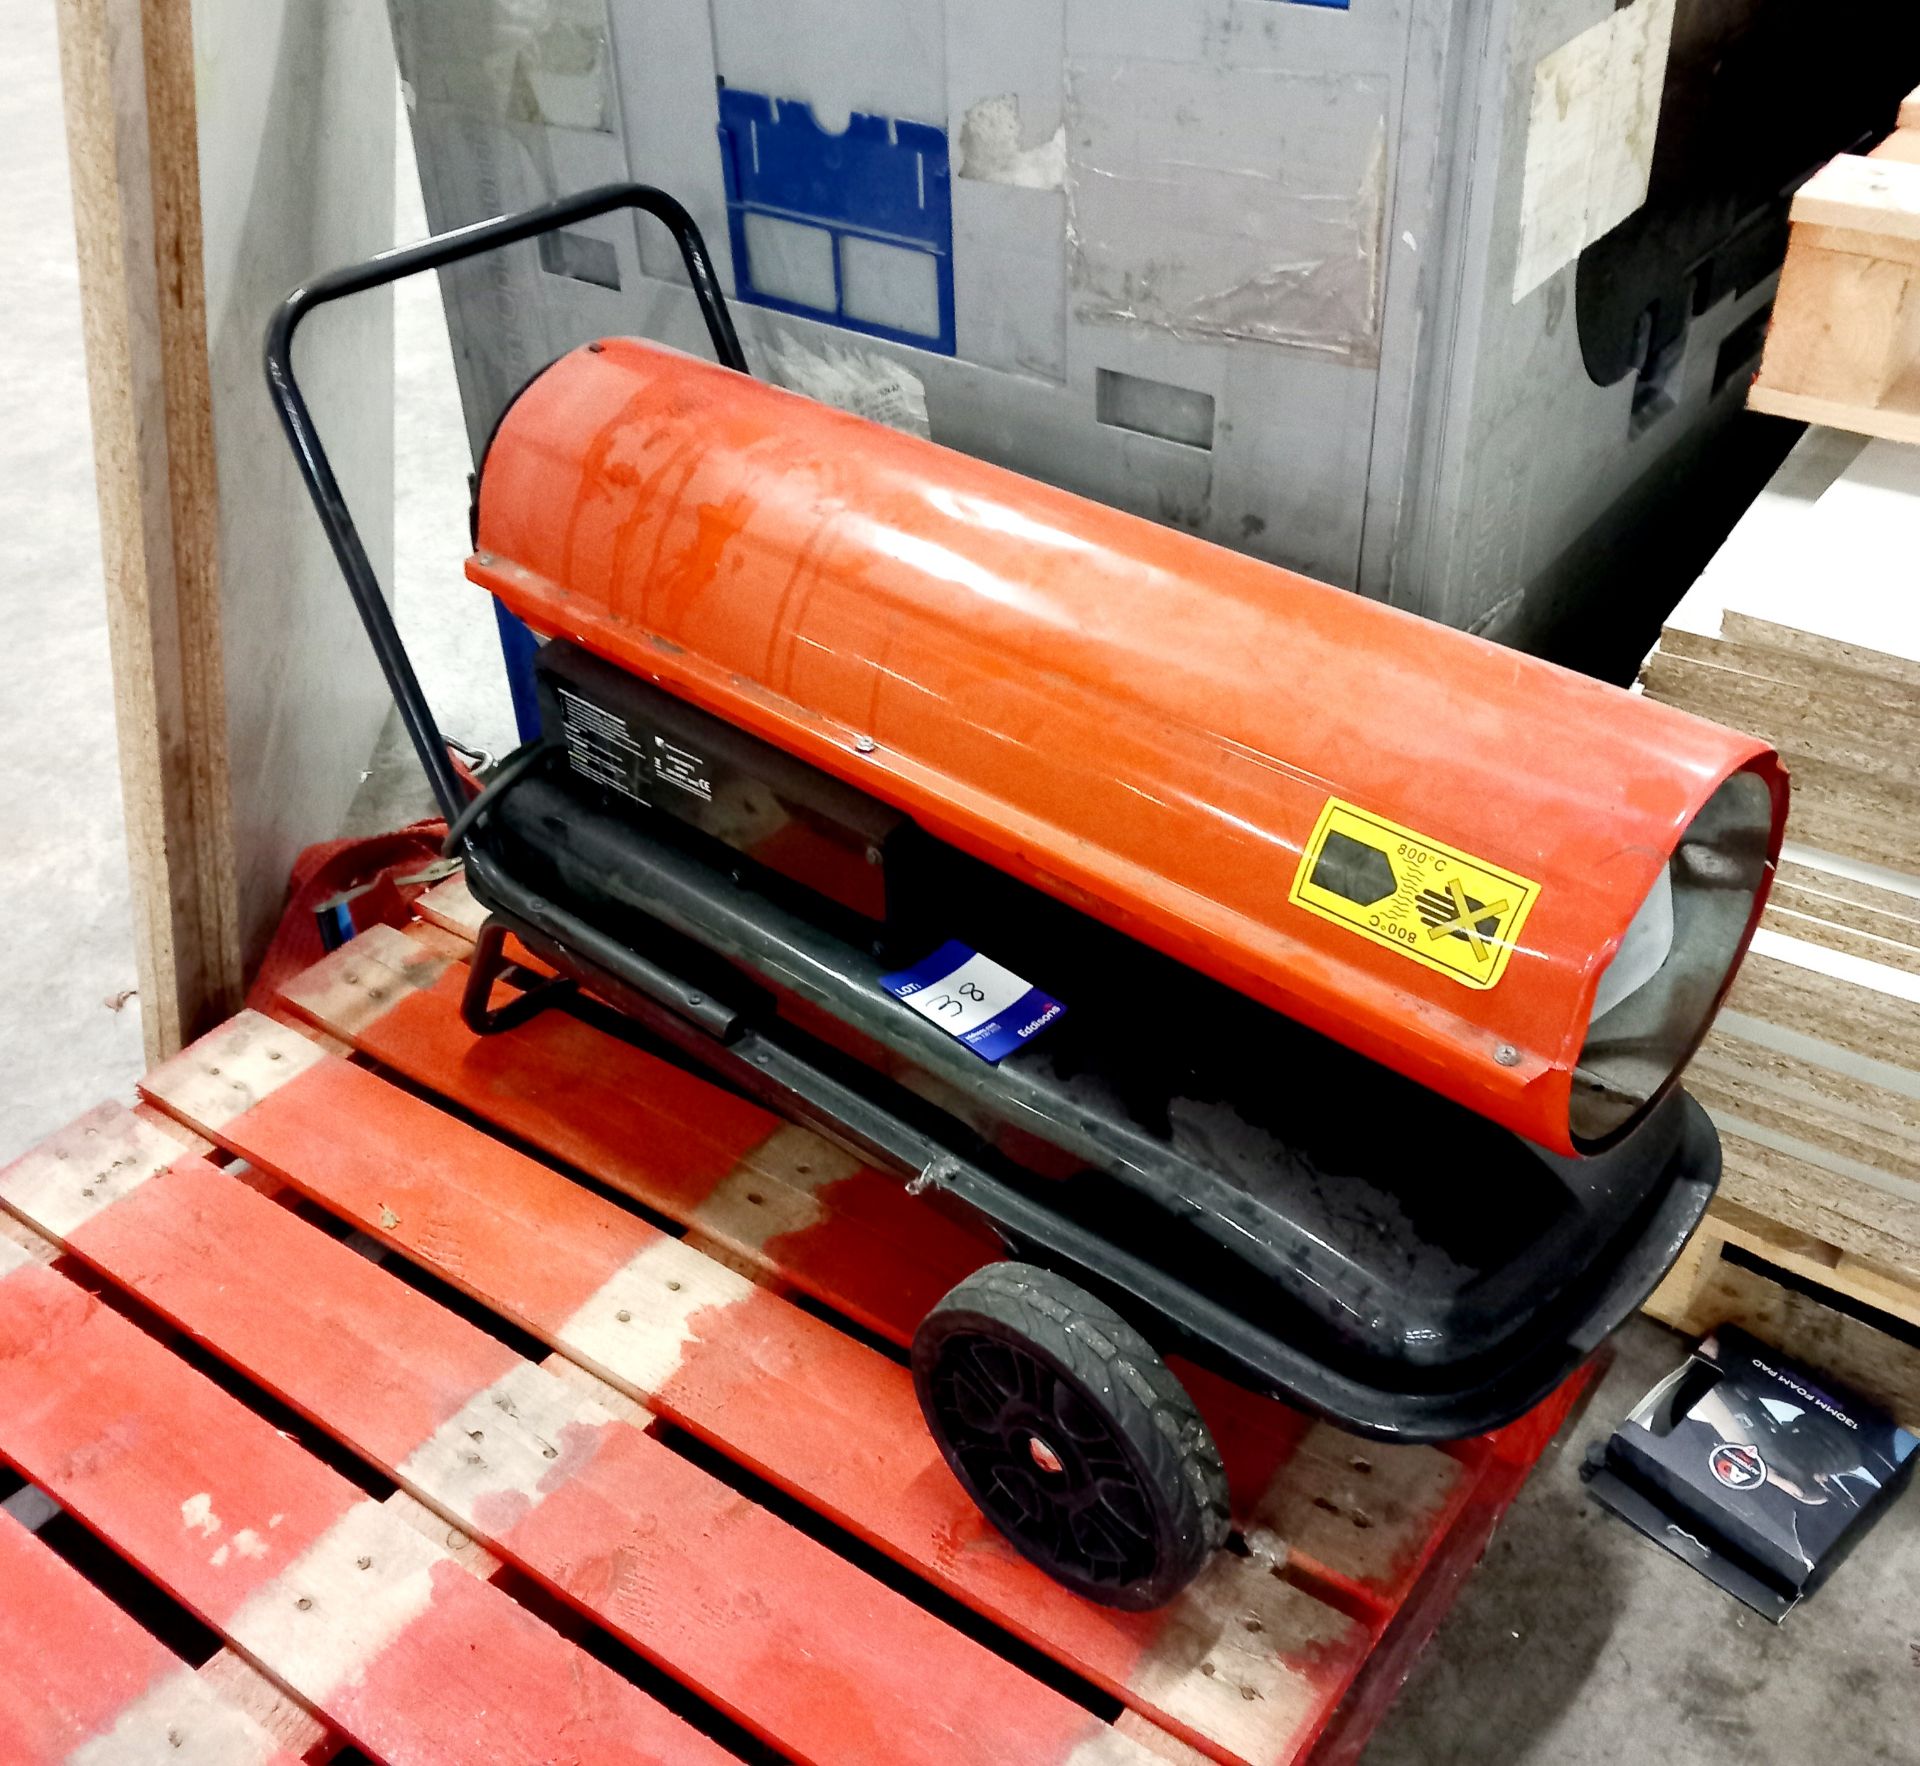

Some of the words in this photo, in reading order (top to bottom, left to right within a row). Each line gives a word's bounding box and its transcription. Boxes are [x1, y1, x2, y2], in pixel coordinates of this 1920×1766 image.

[925, 982, 985, 1017] 38
[1017, 1005, 1061, 1038] Eddisons
[1751, 1358, 1779, 1377] PAD
[1779, 1375, 1816, 1402] FOAM
[1814, 1398, 1859, 1430] 130MM
